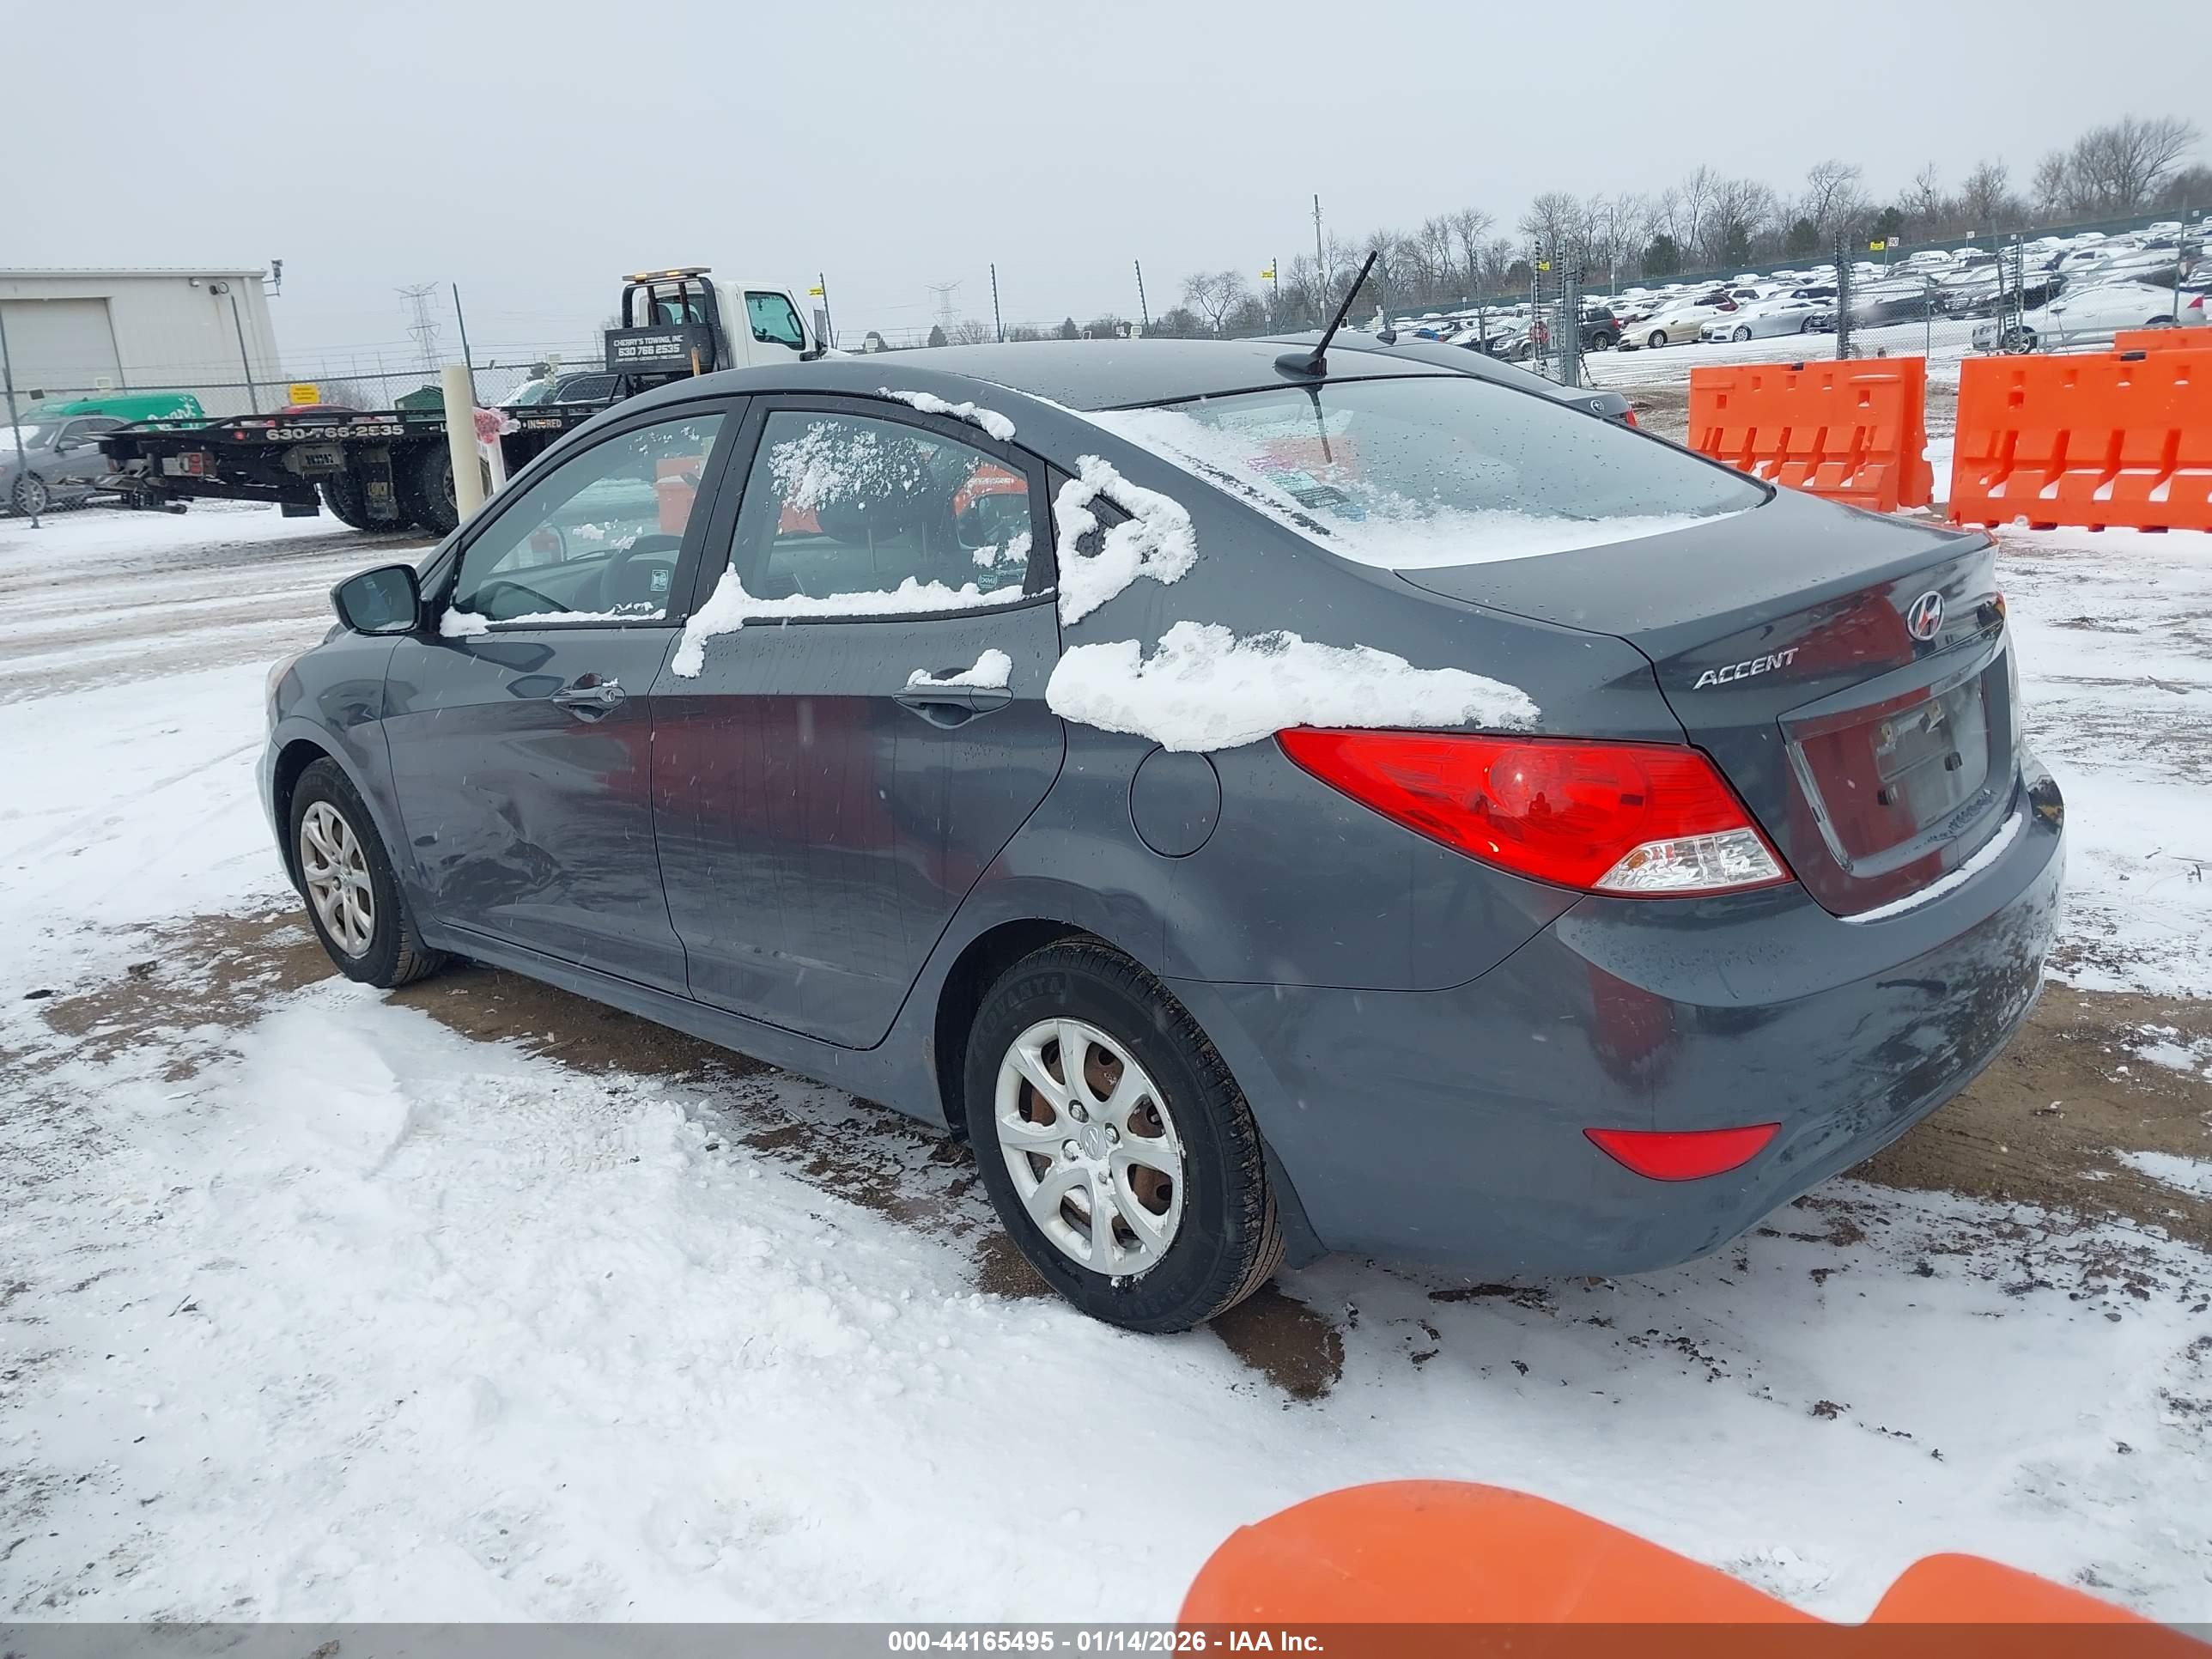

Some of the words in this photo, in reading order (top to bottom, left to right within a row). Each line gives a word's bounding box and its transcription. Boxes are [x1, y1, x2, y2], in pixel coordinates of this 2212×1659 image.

[613, 337, 644, 347] CHERRY'S
[618, 346, 636, 356] 630
[637, 345, 654, 355] 766
[655, 343, 680, 354] 2535
[527, 418, 562, 429] INSURED
[265, 424, 404, 441] 630-766-2535
[1692, 647, 1800, 690] ACCENT
